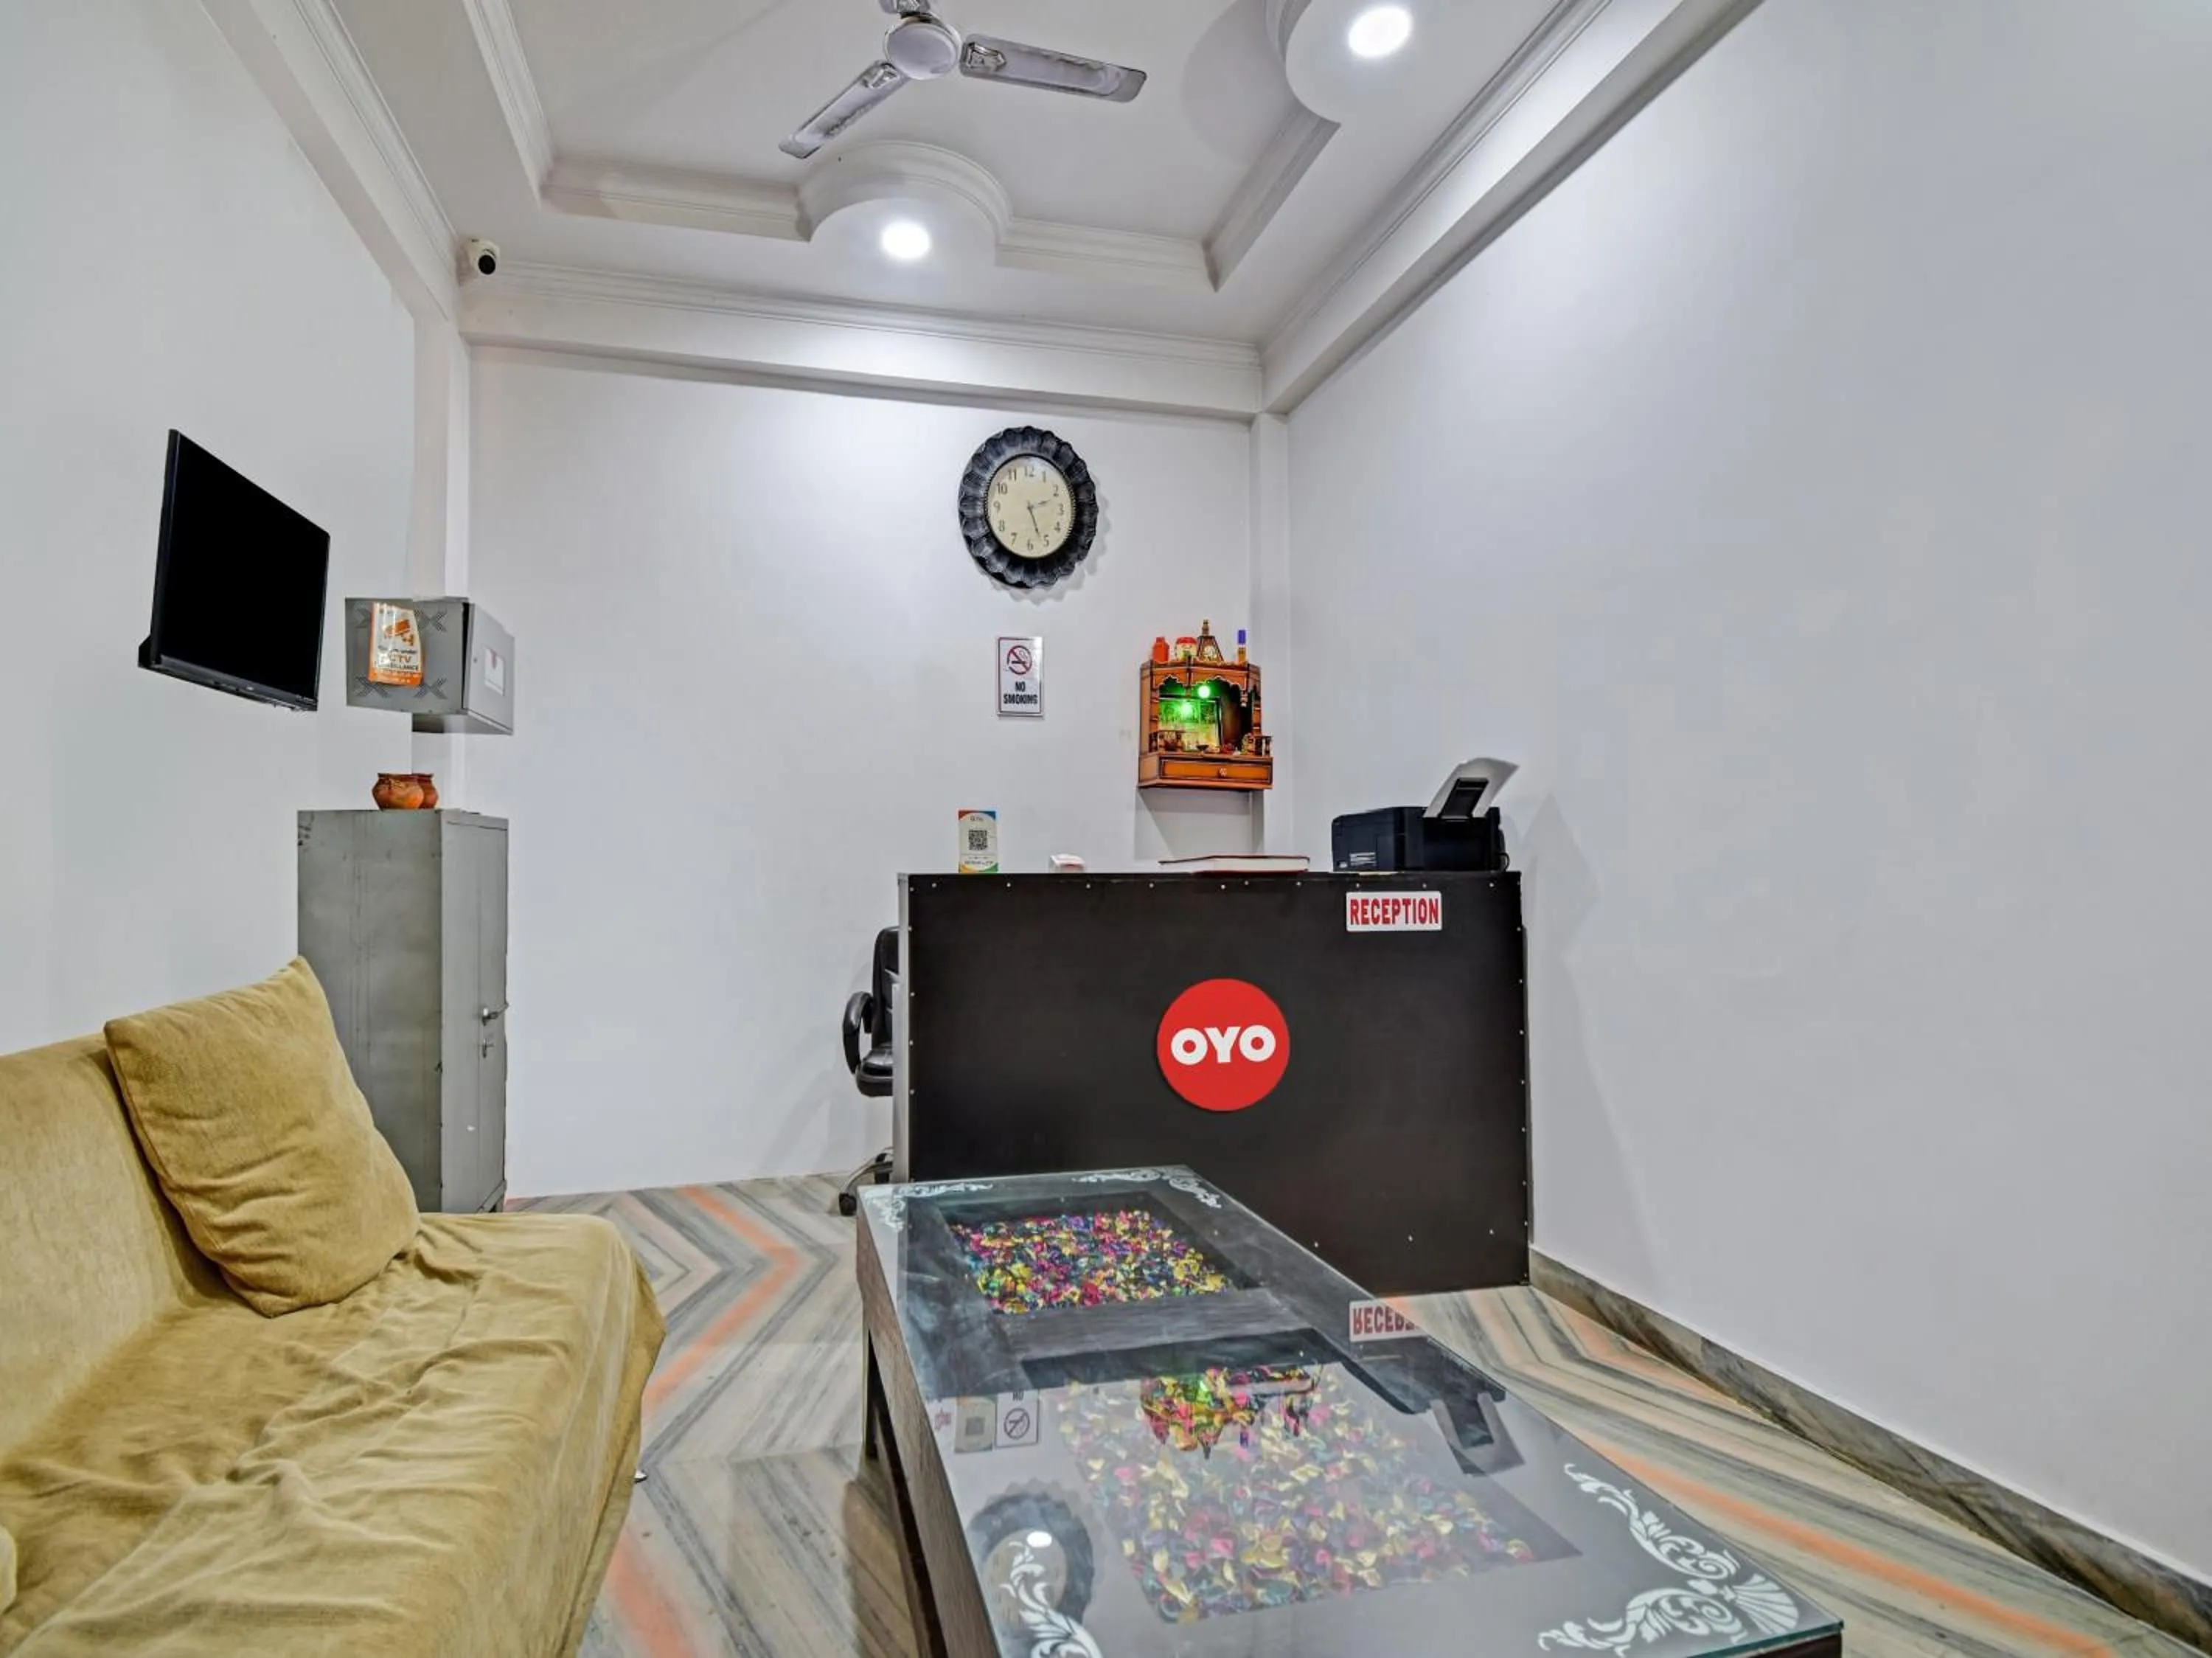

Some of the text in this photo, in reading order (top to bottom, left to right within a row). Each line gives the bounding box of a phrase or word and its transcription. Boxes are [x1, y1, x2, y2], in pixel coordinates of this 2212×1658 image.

[1008, 468, 1017, 482] 11
[997, 482, 1008, 495] 10
[1015, 681, 1026, 693] NO
[1003, 693, 1038, 704] SMOKING
[1349, 898, 1439, 925] RECEPTION
[1170, 1024, 1276, 1066] OYO
